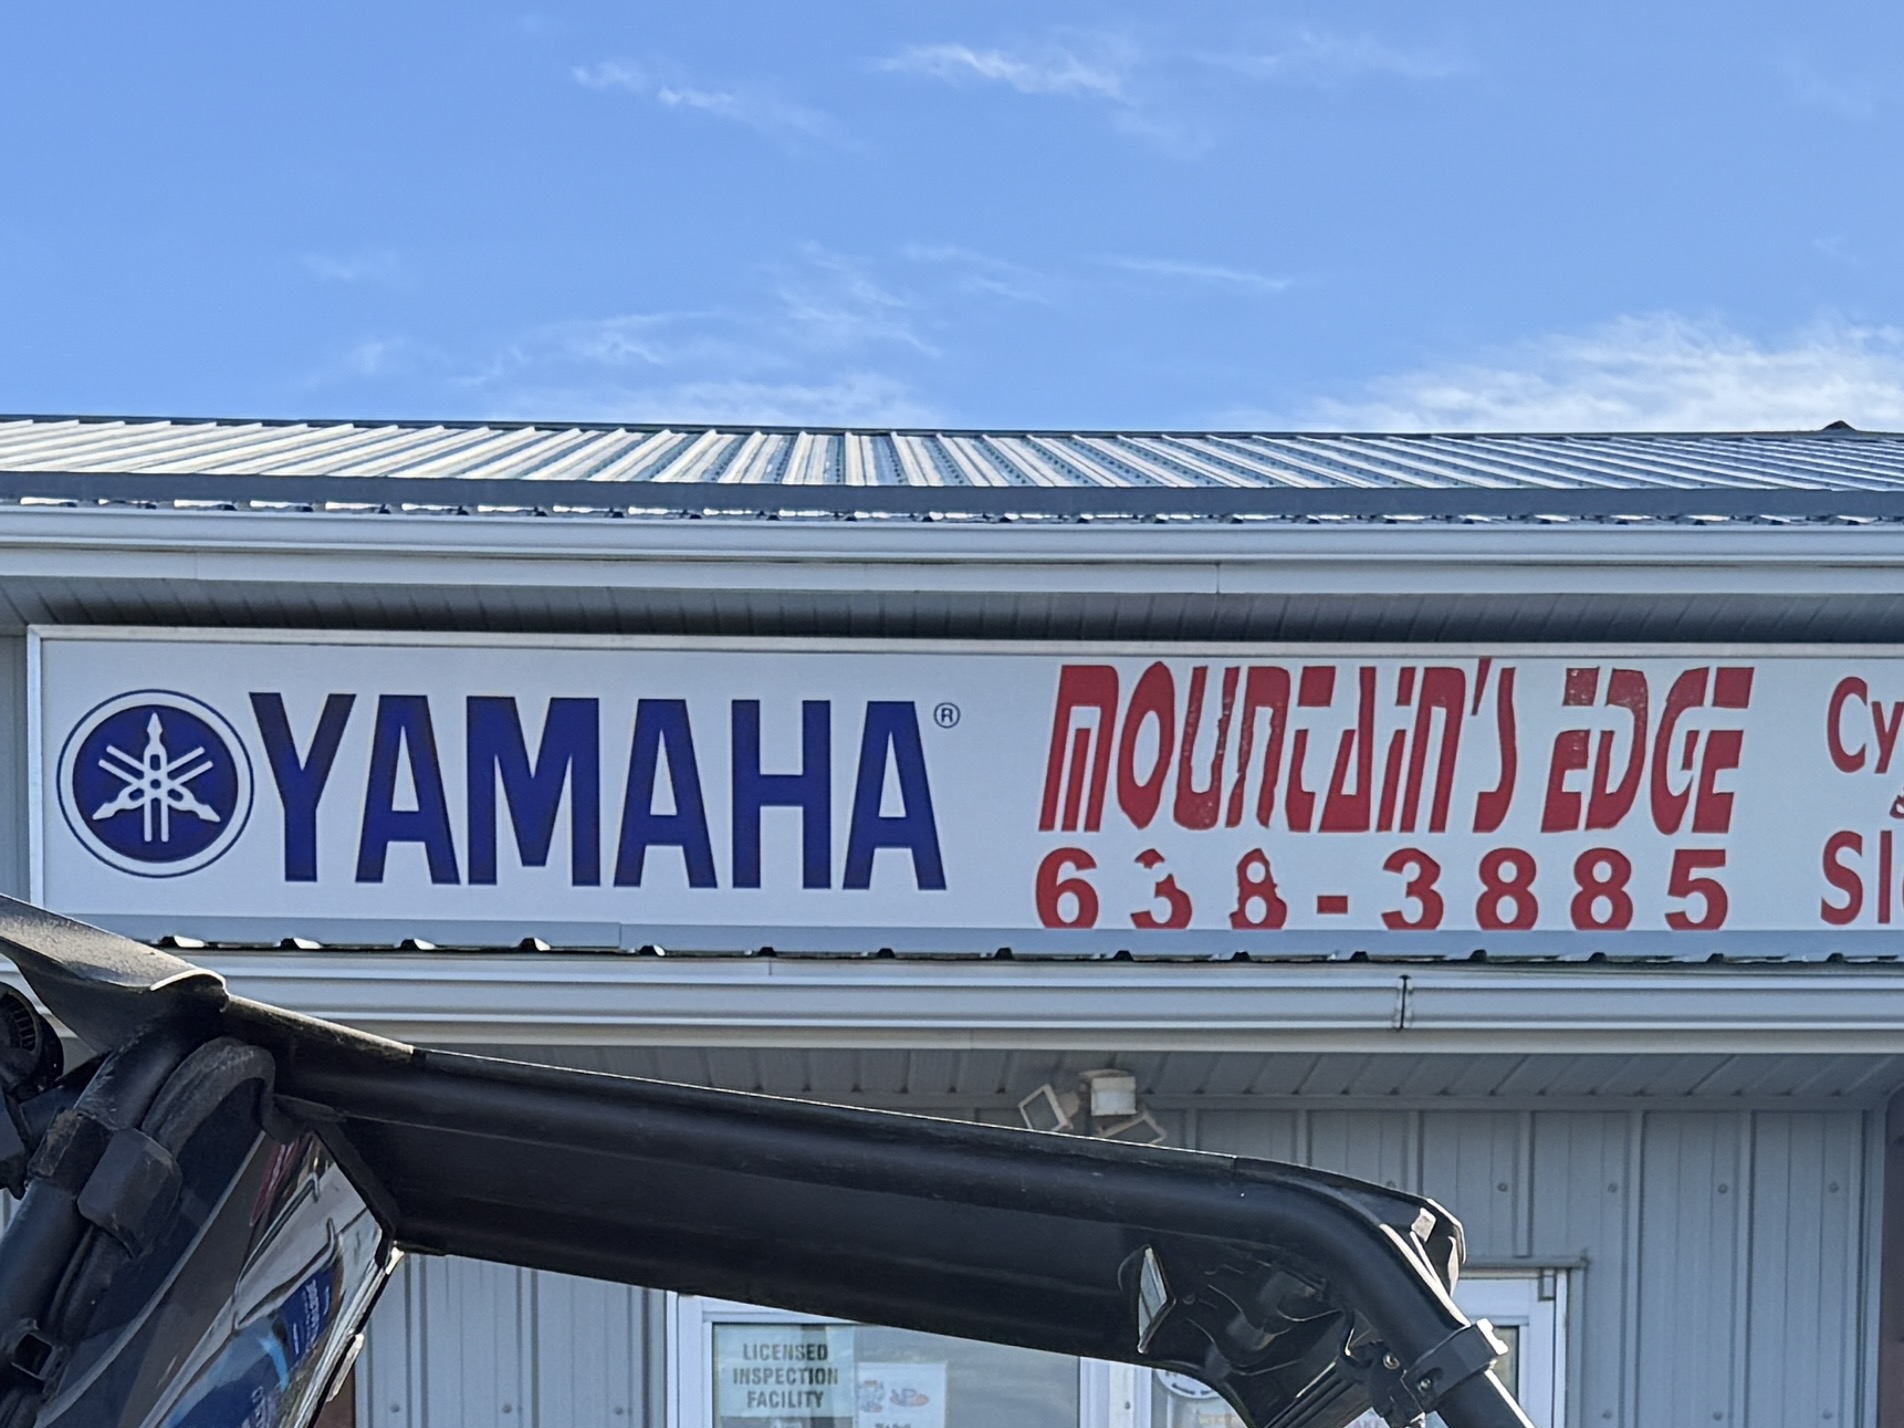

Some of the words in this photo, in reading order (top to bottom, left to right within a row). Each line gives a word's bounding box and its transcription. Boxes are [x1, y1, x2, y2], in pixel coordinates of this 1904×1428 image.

[1540, 665, 1756, 836] EDGE
[248, 691, 947, 891] YAMAHA
[1035, 847, 1728, 931] 638-3885
[733, 1367, 838, 1385] INSPECTION
[743, 1343, 828, 1361] LICENSED
[747, 1391, 824, 1408] FACILITY
